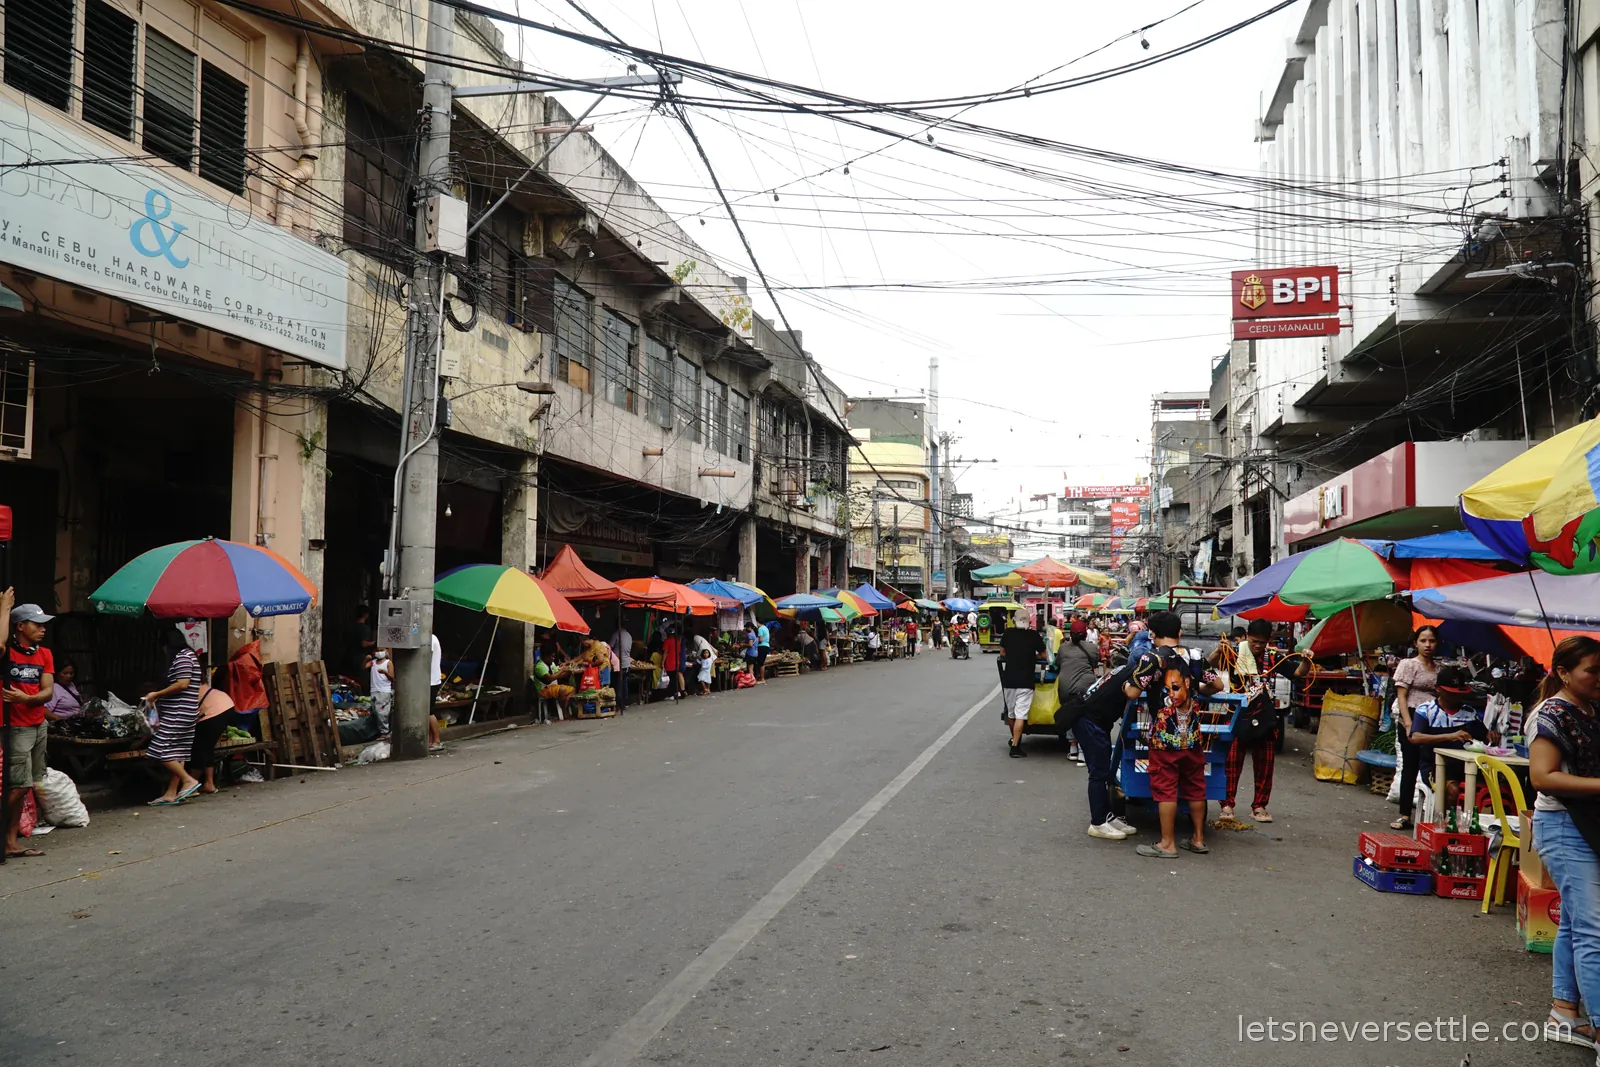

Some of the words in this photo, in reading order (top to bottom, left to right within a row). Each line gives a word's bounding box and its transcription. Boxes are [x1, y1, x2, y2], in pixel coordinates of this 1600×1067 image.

[129, 188, 190, 269] &
[12, 235, 60, 260] Manalili
[104, 266, 141, 289] Ermita,
[144, 281, 169, 297] Cebu
[171, 290, 190, 305] City
[192, 297, 213, 311] 6000
[243, 315, 257, 326] No.
[41, 230, 97, 259] CEBU
[112, 255, 213, 300] HARDWARE
[224, 296, 327, 341] CORPORATION
[1272, 275, 1331, 304] BPI
[1248, 325, 1276, 334] CEBU
[1278, 322, 1325, 332] MANALILI
[1068, 486, 1083, 498] TH
[1324, 485, 1342, 520] BPI
[263, 603, 304, 612] MICROMATIC
[1360, 868, 1375, 881] pepsi
